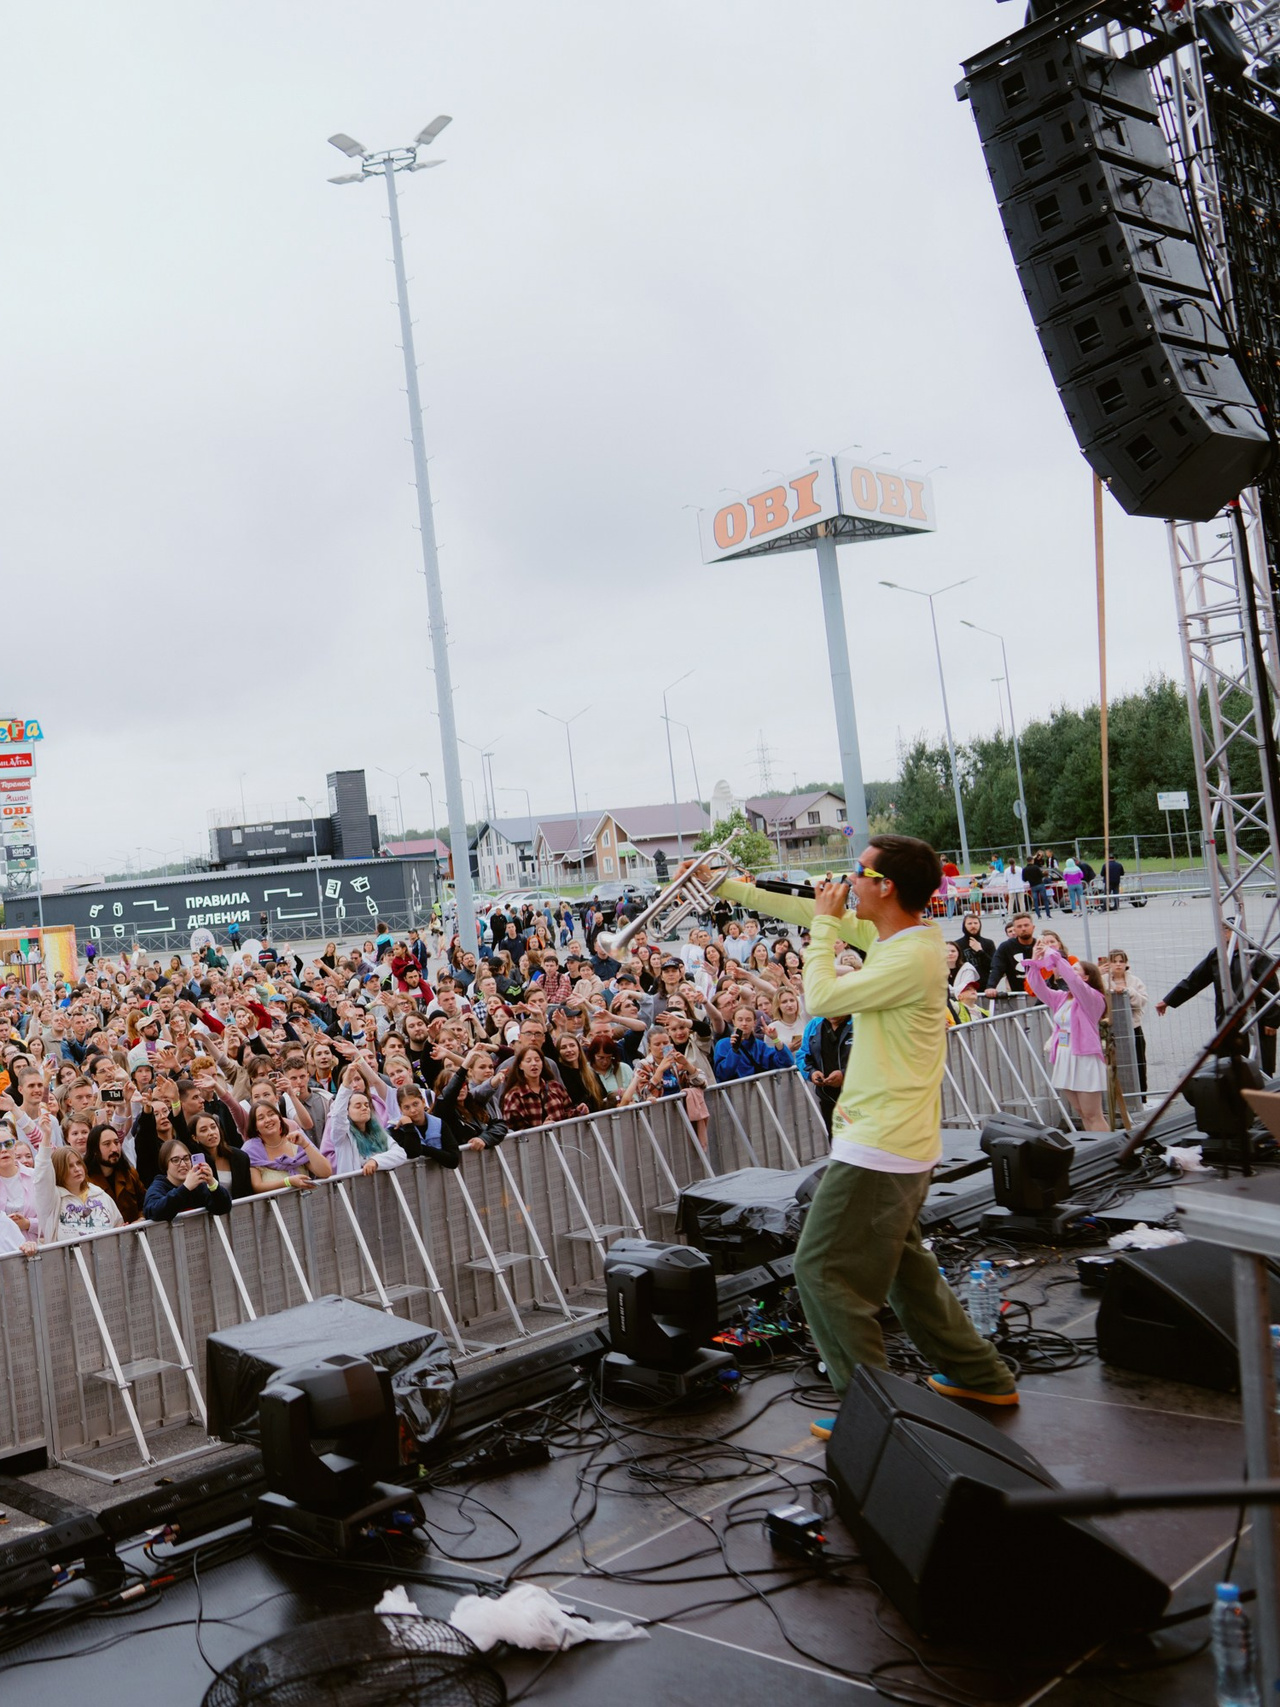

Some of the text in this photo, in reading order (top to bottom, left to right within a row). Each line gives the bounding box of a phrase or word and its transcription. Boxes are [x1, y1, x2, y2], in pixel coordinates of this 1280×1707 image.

[850, 465, 928, 522] OBI
[713, 470, 822, 549] OBI
[3, 806, 32, 815] OBI
[185, 892, 250, 909] ПРАВИЛА
[187, 910, 250, 930] ДЕЛЕНИЯ
